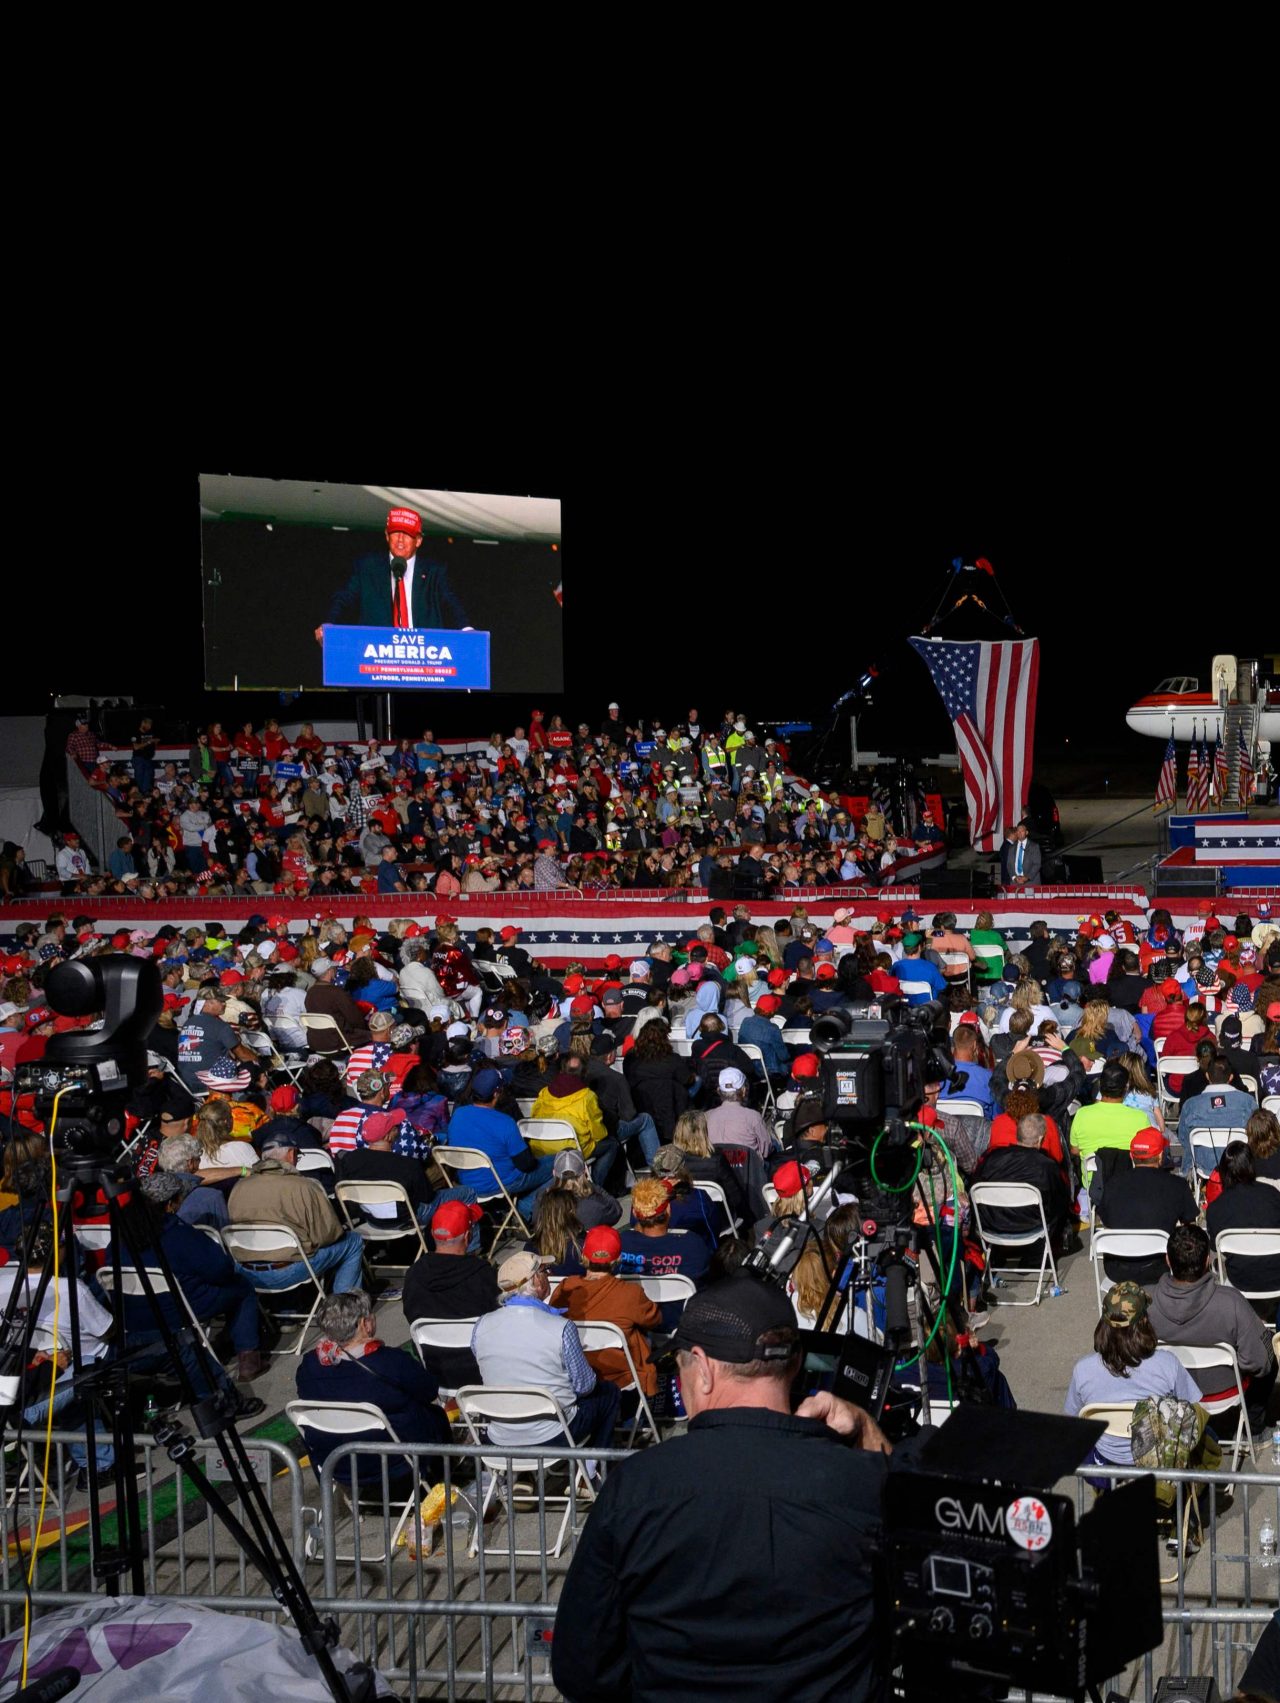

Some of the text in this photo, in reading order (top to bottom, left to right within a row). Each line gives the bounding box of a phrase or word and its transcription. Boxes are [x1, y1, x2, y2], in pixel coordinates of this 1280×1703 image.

[392, 634, 425, 644] SAVE
[364, 644, 452, 660] AMERICA
[620, 1251, 682, 1266] PRO-GOD
[935, 1497, 1005, 1536] GVM
[1014, 1520, 1043, 1532] RSBN
